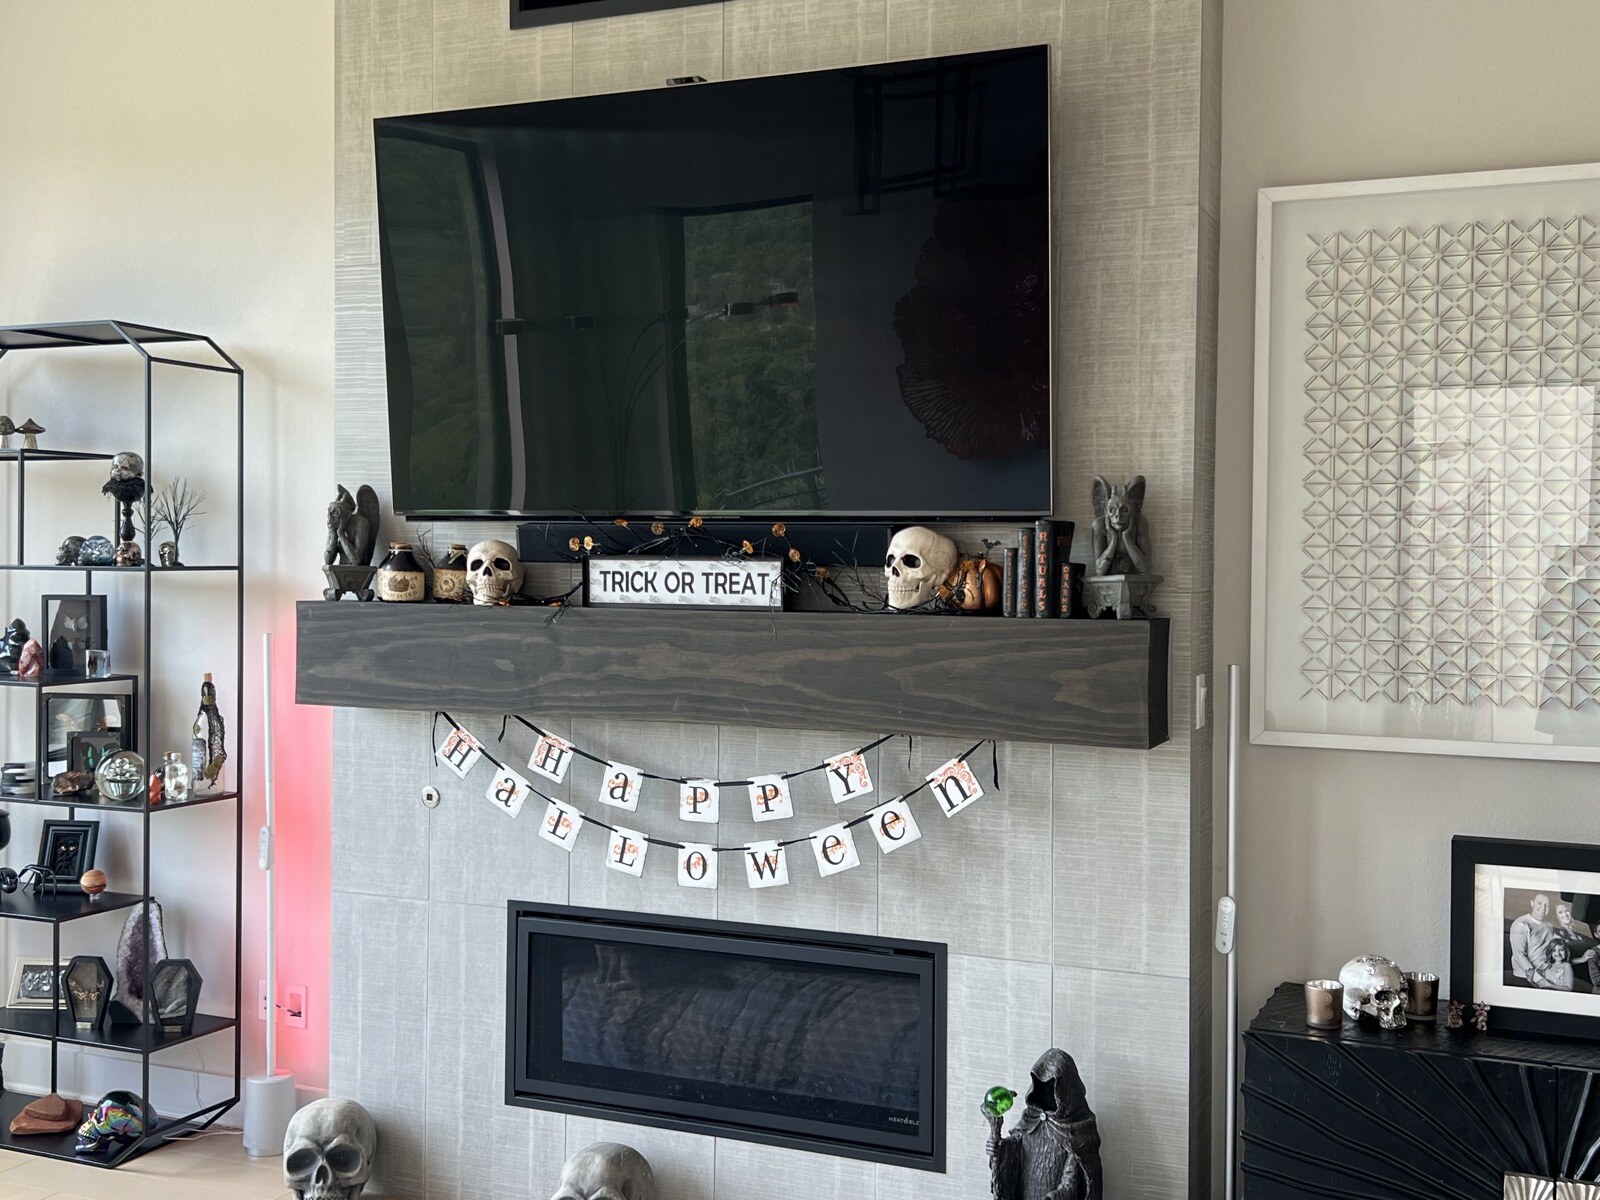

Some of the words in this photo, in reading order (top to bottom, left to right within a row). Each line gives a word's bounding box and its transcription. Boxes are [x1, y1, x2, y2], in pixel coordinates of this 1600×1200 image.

[600, 570, 658, 593] TRICK
[663, 571, 695, 594] OR
[701, 572, 770, 595] TREAT
[1038, 531, 1048, 611] RITUALS
